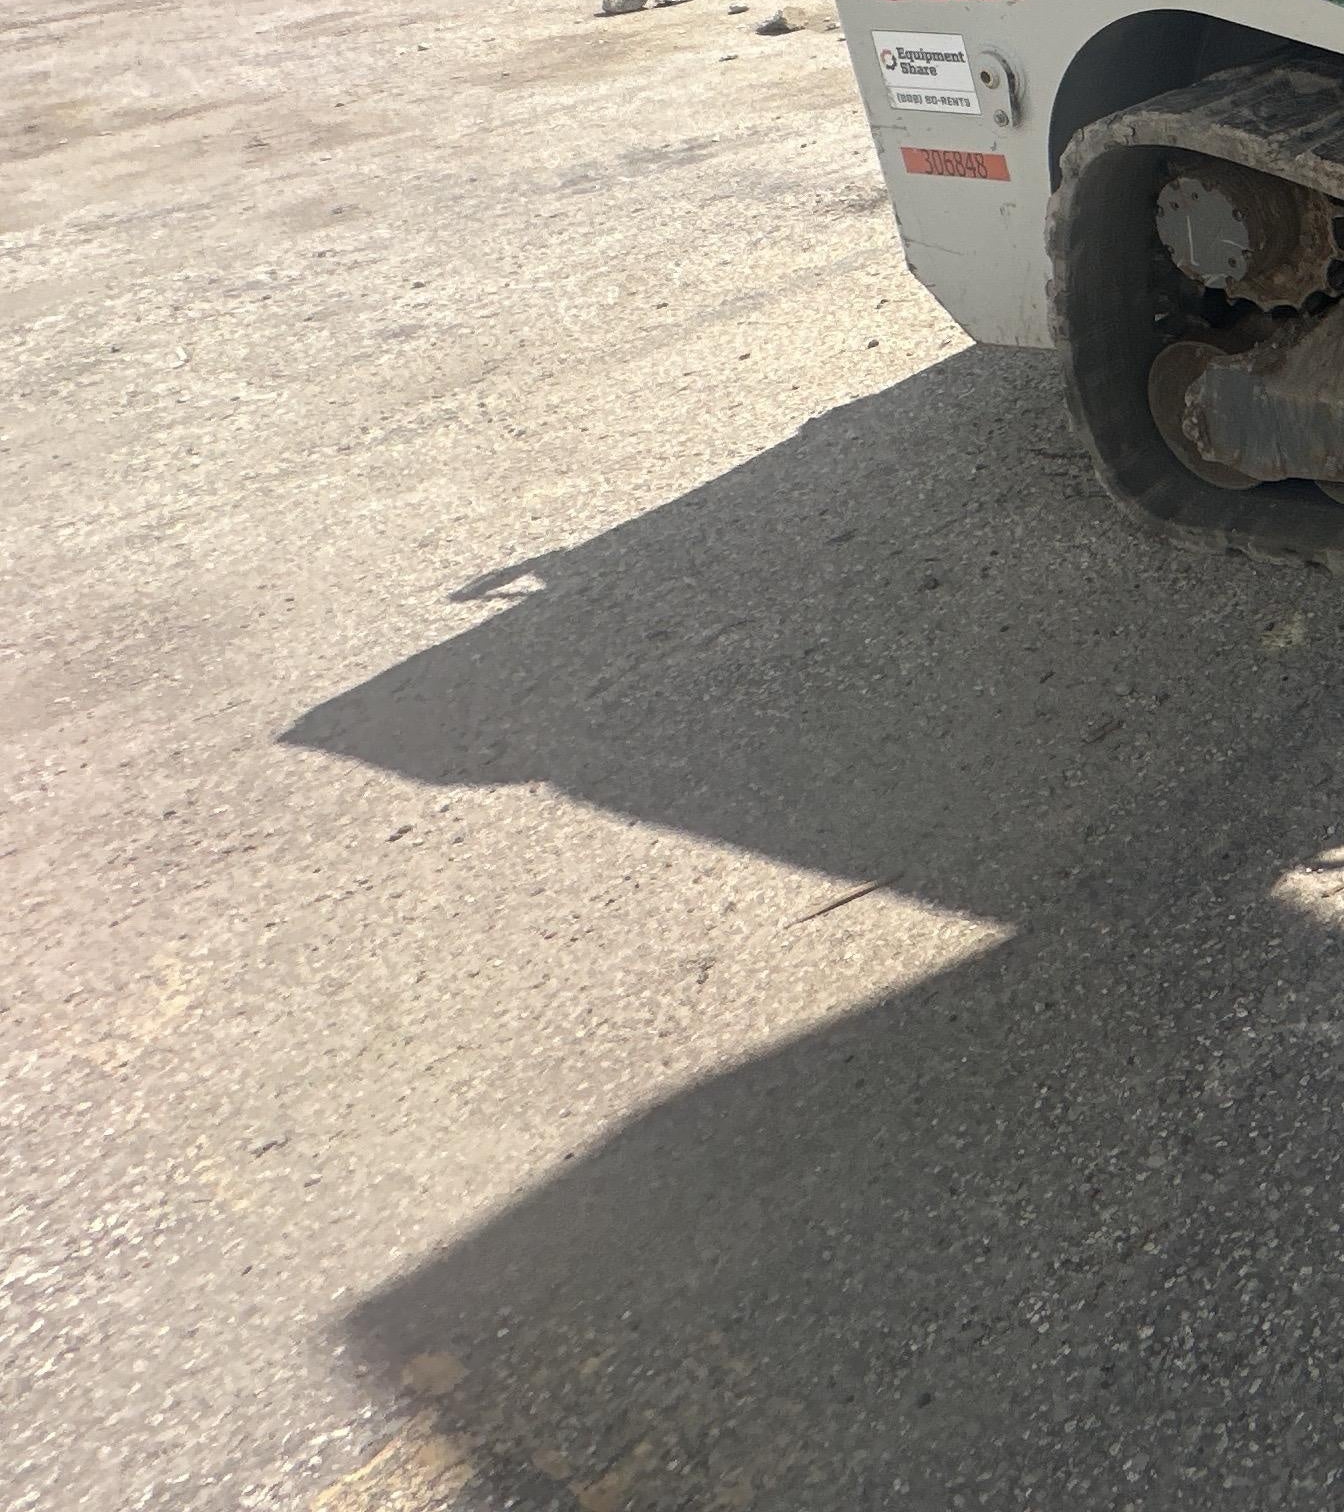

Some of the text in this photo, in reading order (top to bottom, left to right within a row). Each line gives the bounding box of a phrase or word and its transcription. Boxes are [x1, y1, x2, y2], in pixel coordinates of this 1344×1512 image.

[896, 47, 967, 65] Equipment
[900, 62, 939, 77] Share
[920, 148, 988, 179] 306848
